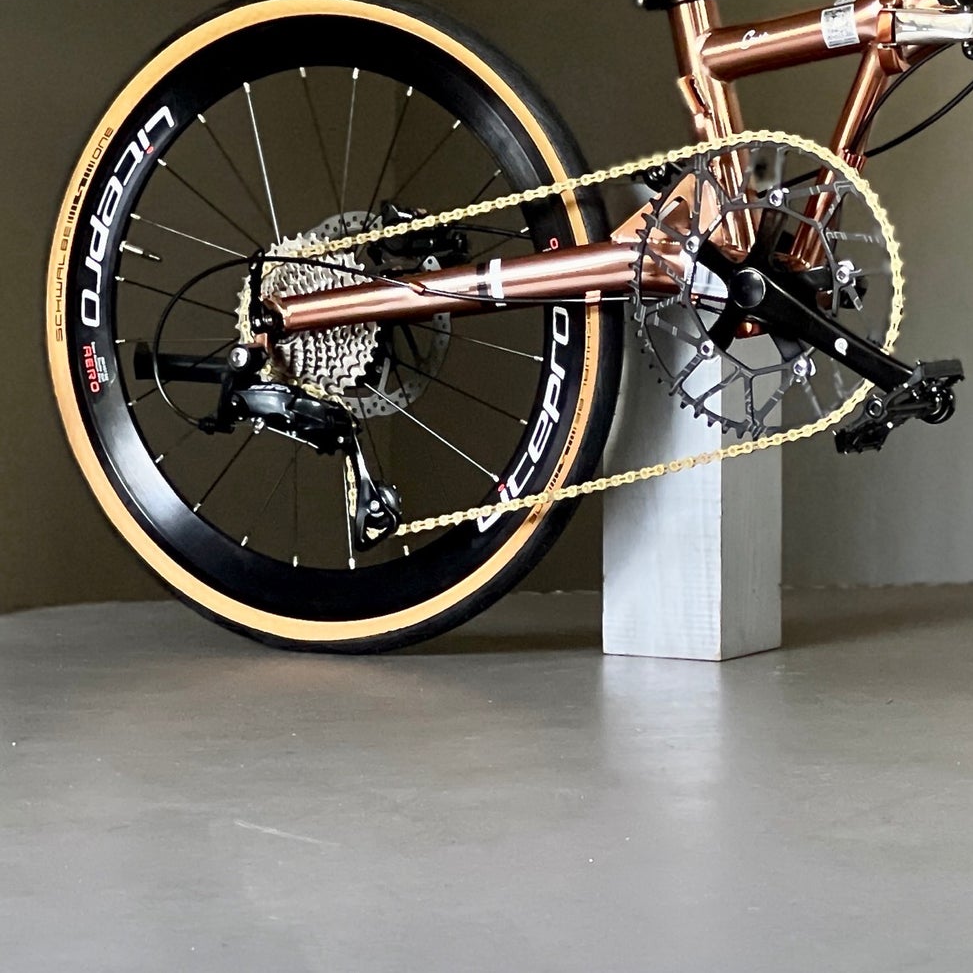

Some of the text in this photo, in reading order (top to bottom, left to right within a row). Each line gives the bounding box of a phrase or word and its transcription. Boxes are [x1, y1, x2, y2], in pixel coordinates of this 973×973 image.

[54, 127, 114, 342] SCHWALBE ONE
[83, 345, 101, 394] AERO
